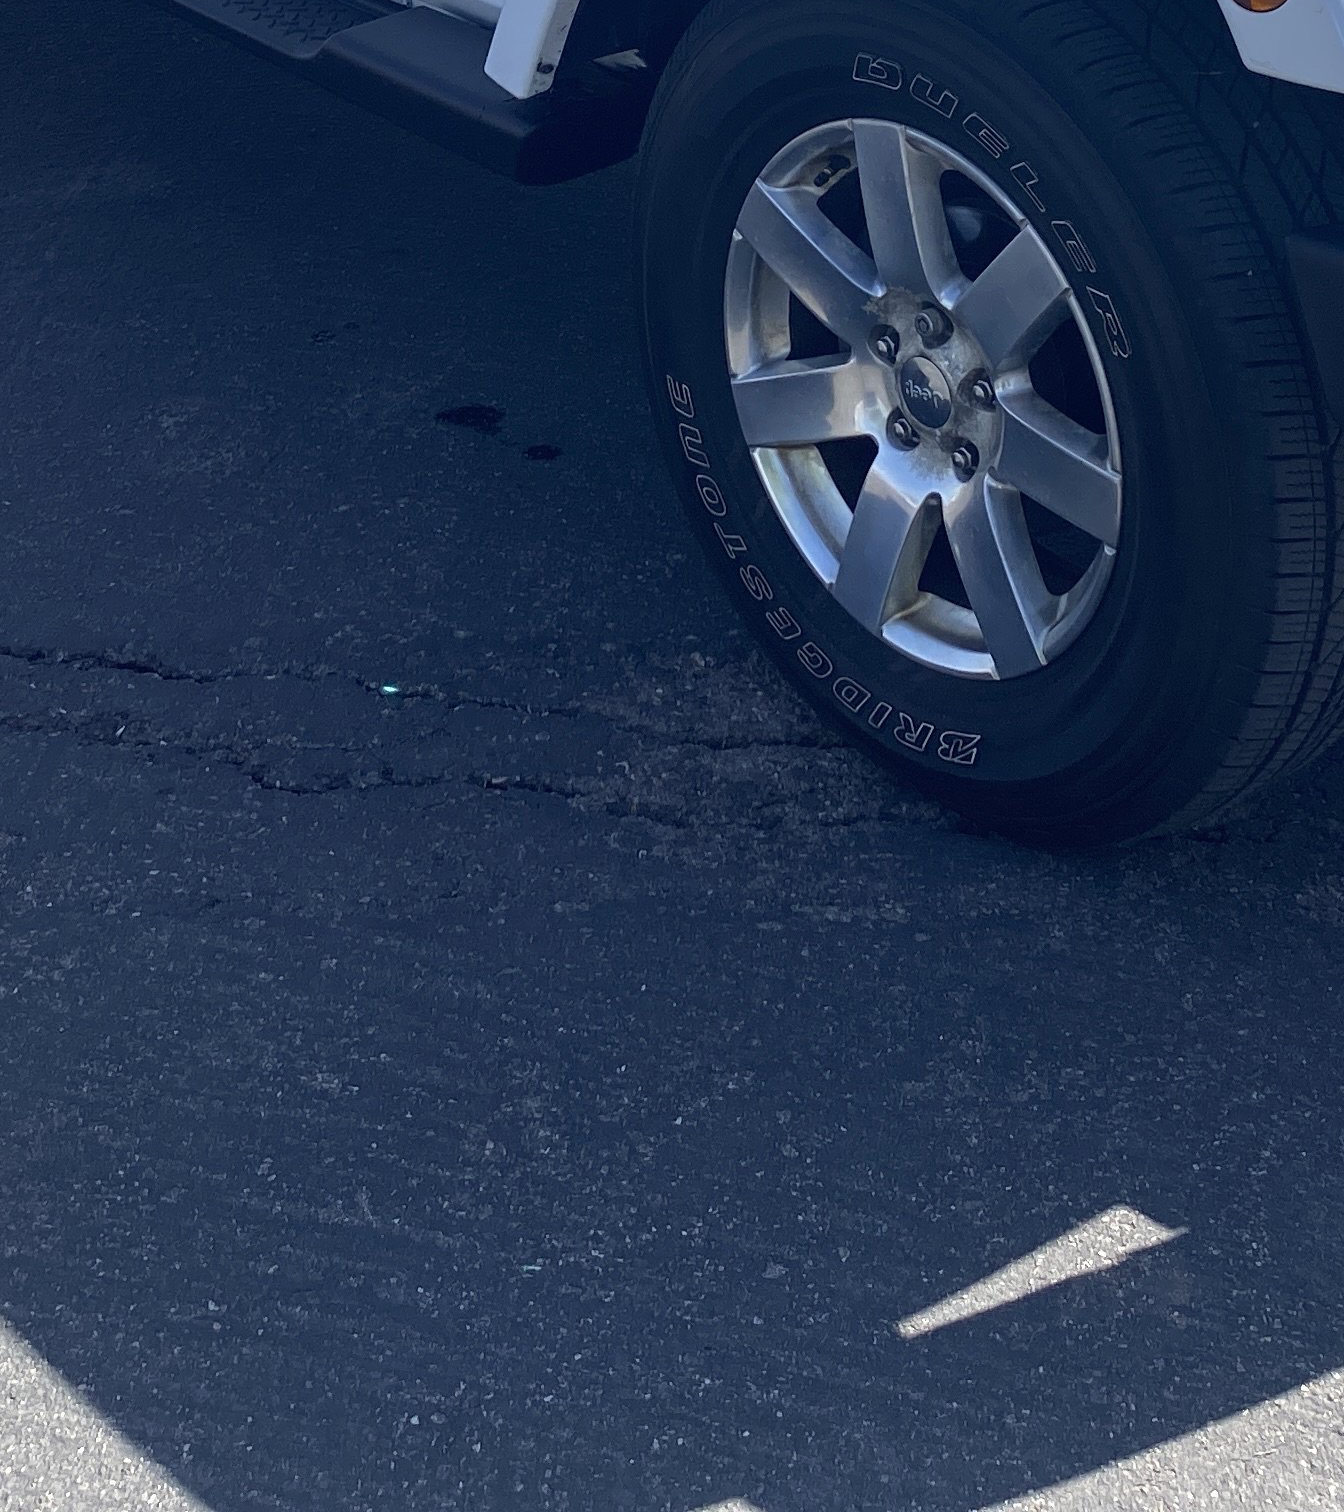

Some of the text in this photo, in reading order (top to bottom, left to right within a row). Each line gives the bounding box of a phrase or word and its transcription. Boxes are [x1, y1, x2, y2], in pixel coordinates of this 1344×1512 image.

[852, 52, 1133, 359] DUELER
[905, 379, 944, 409] Jeep
[666, 374, 981, 766] BRIDGESTONE
